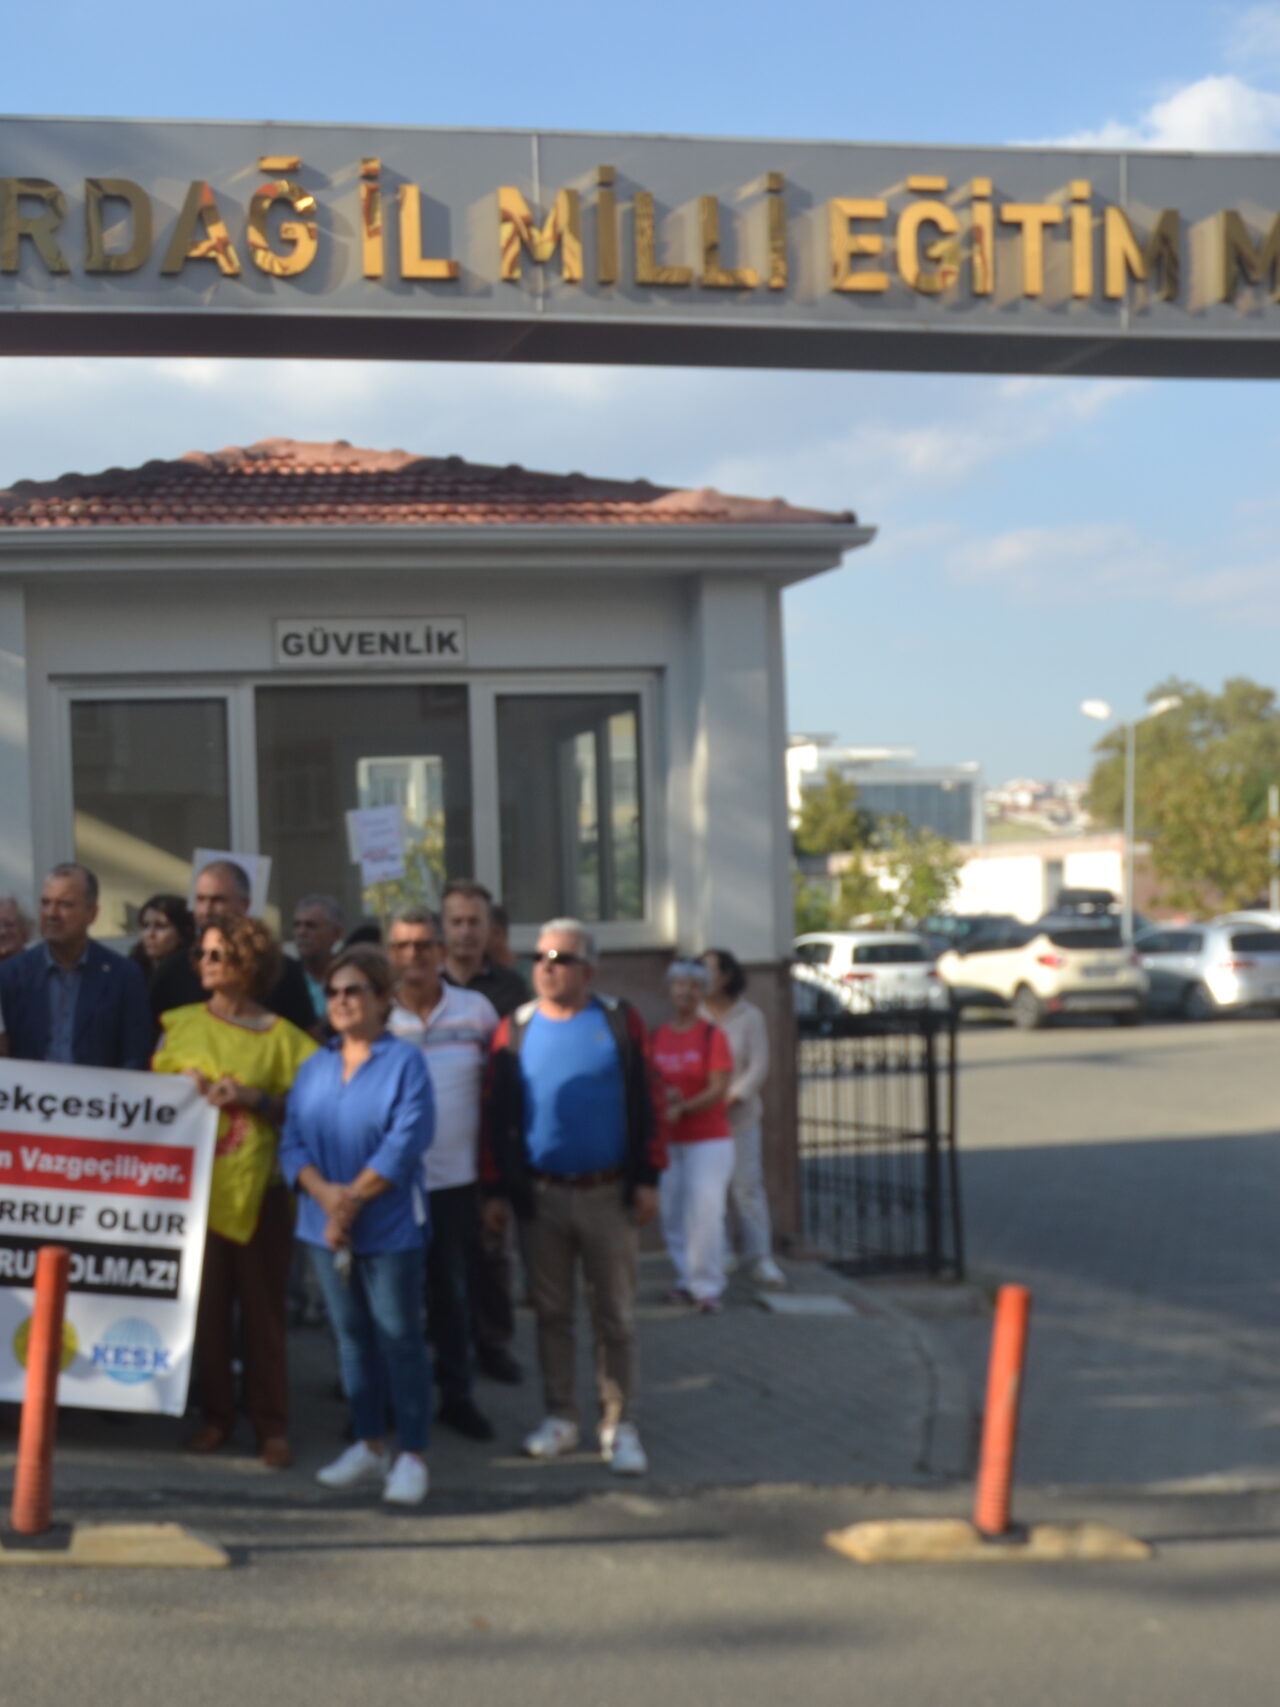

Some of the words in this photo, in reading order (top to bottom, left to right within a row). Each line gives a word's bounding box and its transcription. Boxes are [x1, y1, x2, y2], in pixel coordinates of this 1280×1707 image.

[360, 157, 459, 281] İL
[498, 164, 787, 290] MİLLİ
[828, 174, 1180, 302] EĞİTİM
[281, 625, 459, 656] GÜVENLİK
[21, 1147, 186, 1185] Vazgeçiliyor.
[96, 1208, 187, 1235] OLUR
[91, 1344, 171, 1369] KESK
